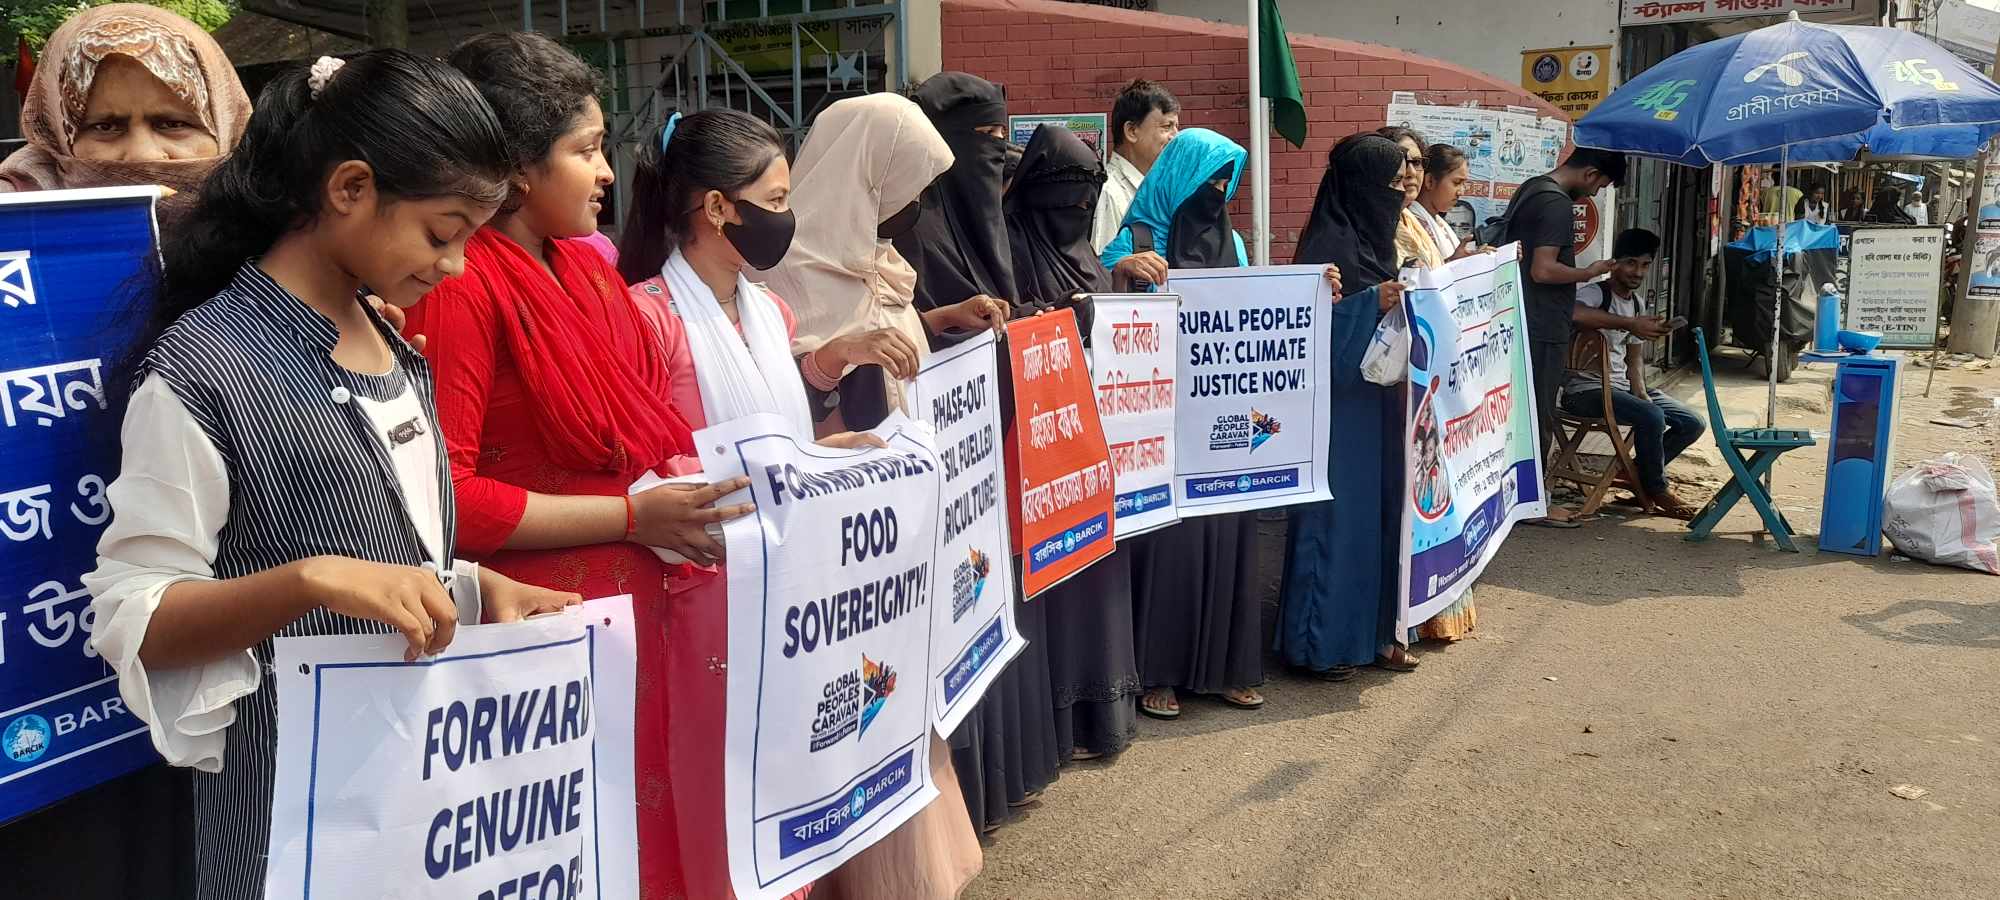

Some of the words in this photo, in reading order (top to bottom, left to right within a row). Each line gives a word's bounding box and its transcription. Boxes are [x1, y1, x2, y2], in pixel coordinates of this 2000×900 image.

[1179, 310, 1234, 334] RURAL
[1239, 306, 1312, 332] PEOPLES
[1190, 341, 1230, 366] SAY:
[1234, 337, 1306, 364] CLIMATE
[1190, 371, 1258, 398] JUSTICE
[1262, 368, 1306, 393] NOW!
[932, 374, 986, 435] PHASE-OUT
[1210, 430, 1250, 441] CARAVAN
[1212, 422, 1250, 433] PEOPLES
[1216, 413, 1250, 432] GLOBAL
[941, 447, 959, 483] SIL
[957, 423, 994, 471] FUELLED
[1252, 474, 1291, 486] BARCIK
[943, 471, 996, 548] RICULTURE!
[841, 506, 898, 566] FOOD
[1075, 520, 1104, 542] BARCIK
[783, 562, 929, 658] SOVEREIGNTY!
[823, 668, 861, 699] GLOBAL
[54, 696, 126, 736] BAR
[811, 701, 860, 734] CARAVAN
[817, 687, 861, 718] PEOPLES
[422, 676, 590, 781] FORWARD
[13, 743, 45, 760] BARCIK
[866, 765, 906, 801] BARCIK
[424, 767, 584, 880] GENUINE
[793, 804, 851, 842] বারসিক
